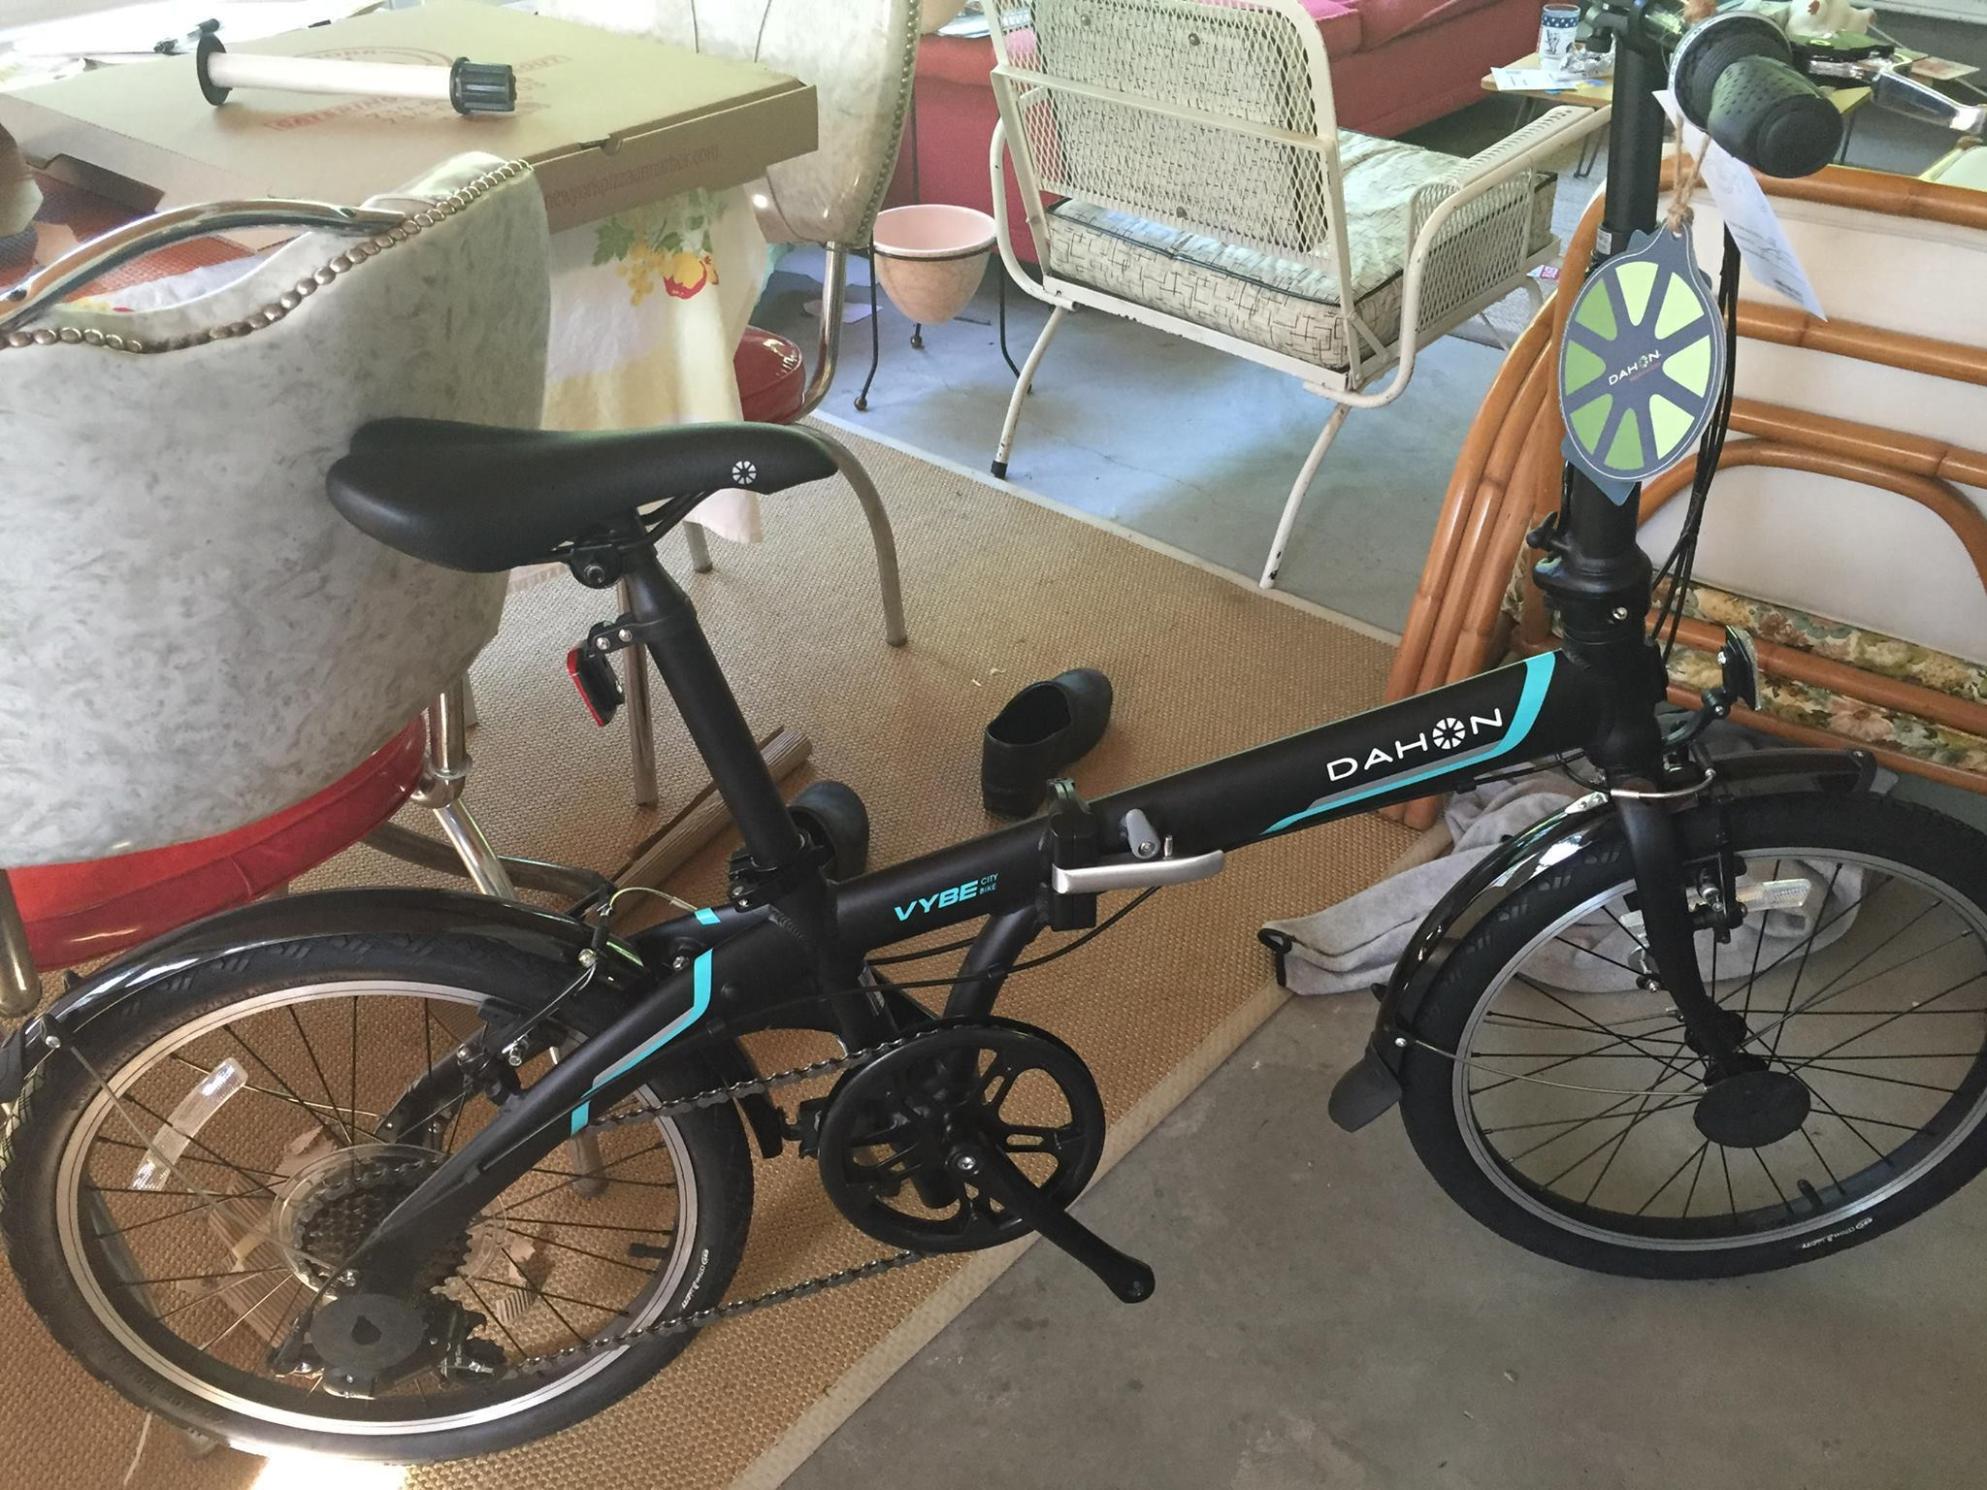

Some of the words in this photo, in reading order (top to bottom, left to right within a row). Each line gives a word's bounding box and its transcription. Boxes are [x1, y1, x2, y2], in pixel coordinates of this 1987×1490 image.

[1608, 349, 1662, 386] DAHON
[1326, 707, 1503, 782] DAHON
[979, 884, 996, 895] BIKE
[980, 873, 998, 885] CITY
[894, 879, 979, 922] VYBE
